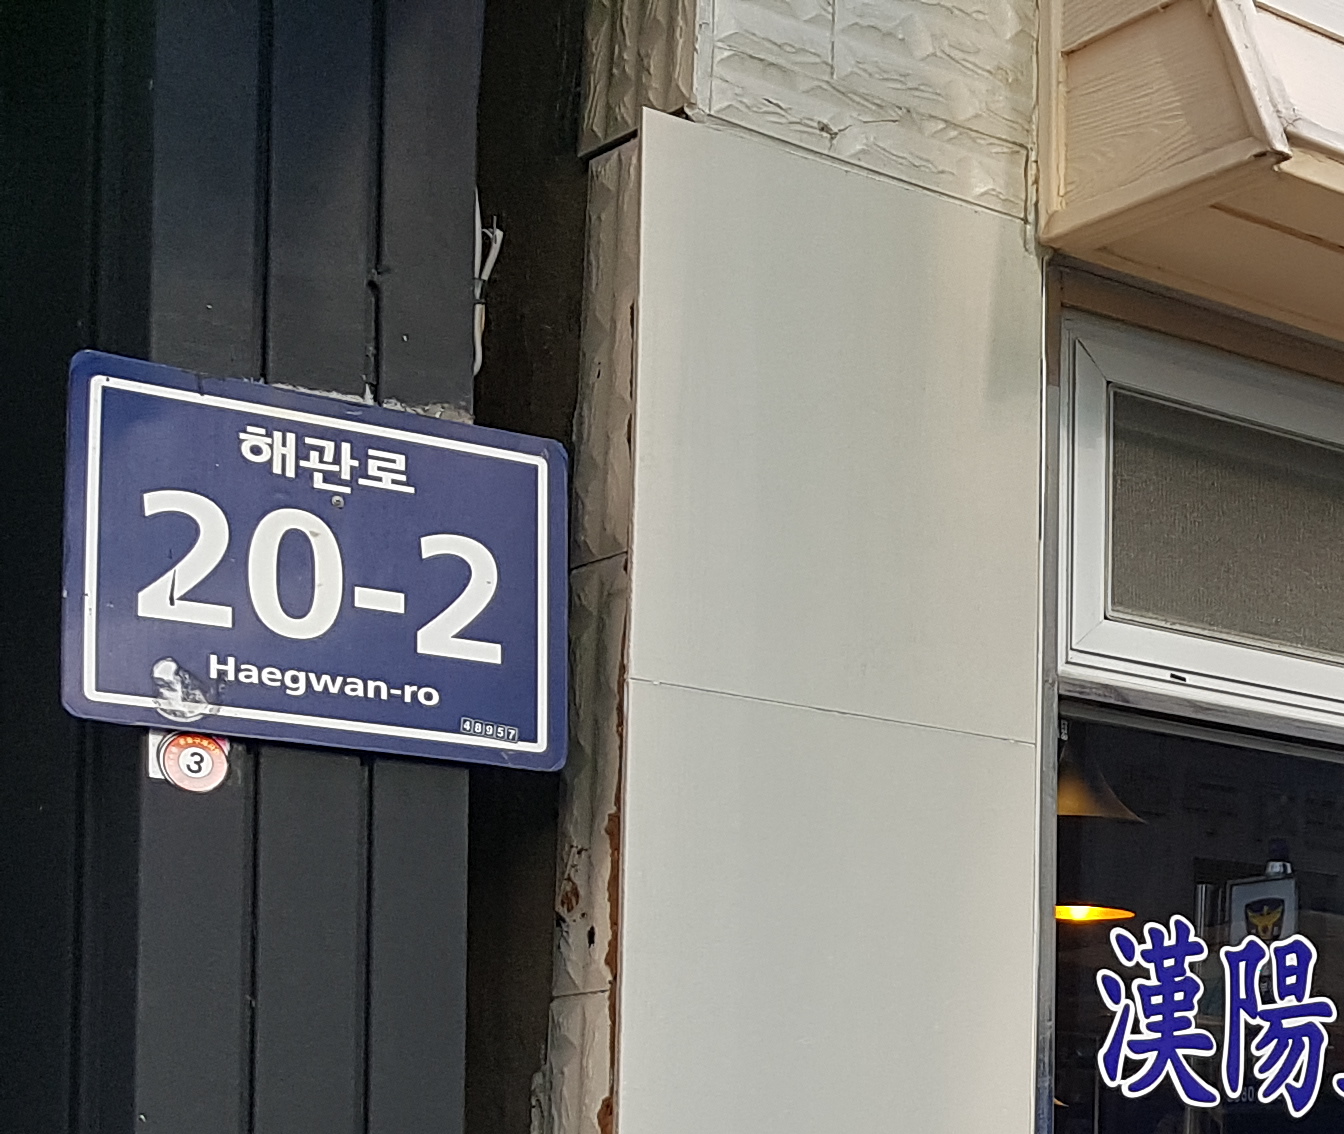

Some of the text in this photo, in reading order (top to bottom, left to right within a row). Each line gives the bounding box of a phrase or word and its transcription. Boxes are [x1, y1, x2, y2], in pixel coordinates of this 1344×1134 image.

[239, 425, 415, 495] 해관로
[137, 489, 502, 665] 20-2
[209, 654, 440, 707] Haegwan-ro
[462, 719, 517, 741] 48957
[186, 751, 205, 774] 3
